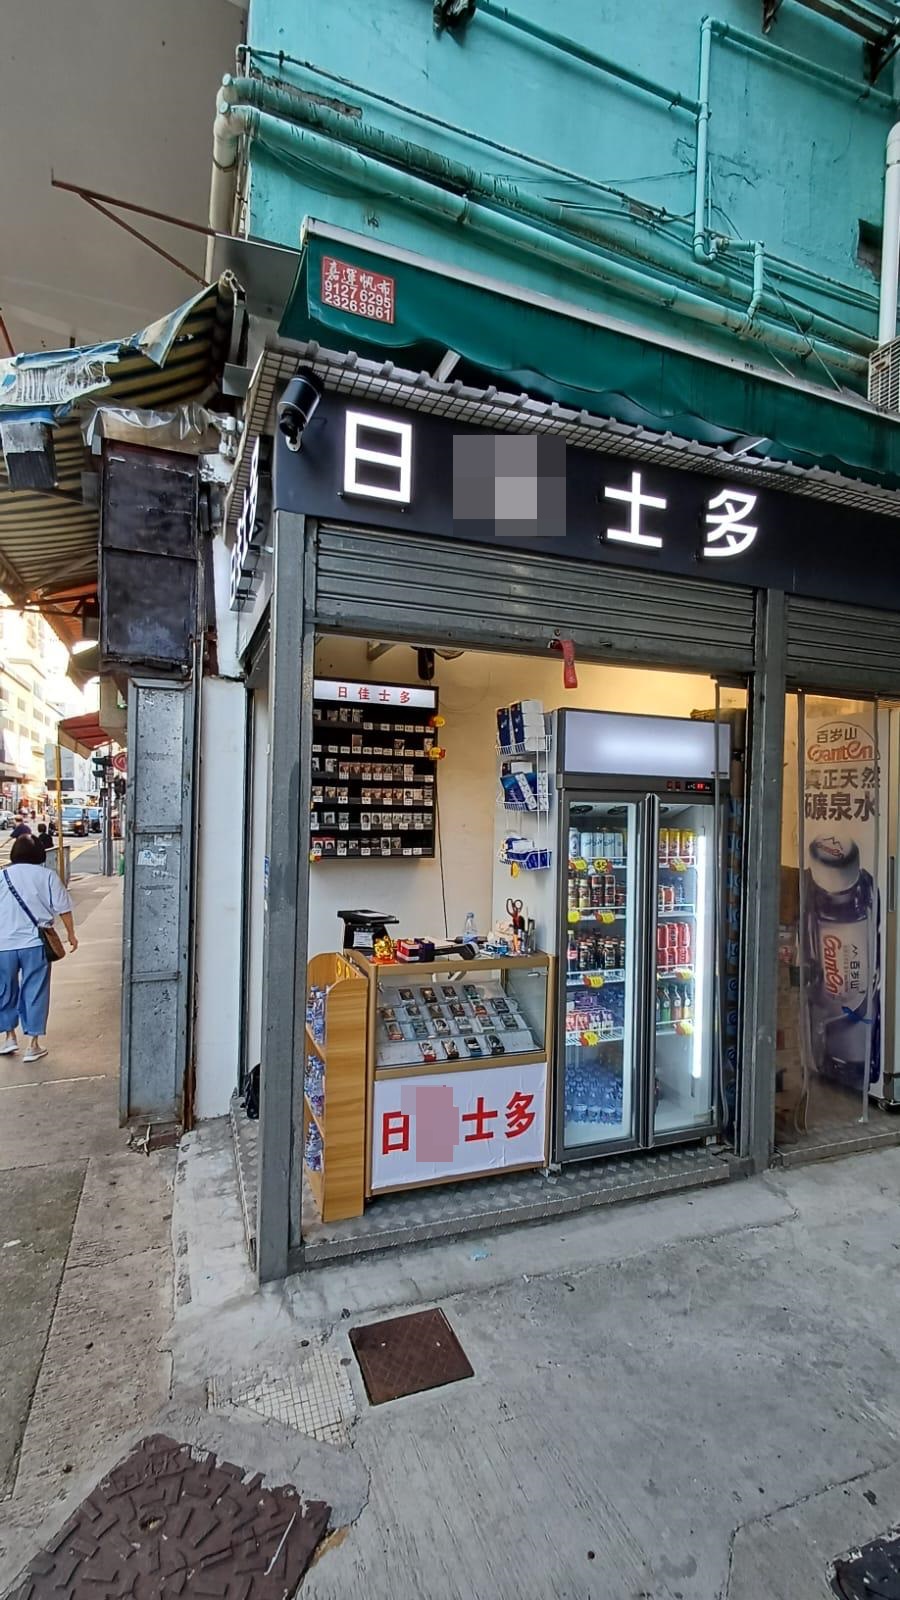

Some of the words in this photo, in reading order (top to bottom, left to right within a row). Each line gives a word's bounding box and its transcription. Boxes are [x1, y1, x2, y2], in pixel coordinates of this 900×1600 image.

[324, 280, 357, 300] 9127
[360, 290, 391, 308] 6295
[324, 292, 357, 312] 2326
[359, 302, 391, 320] 3961
[342, 409, 760, 558] 日士多
[338, 687, 411, 704] 日佳士多
[816, 727, 858, 744] 百岁山
[804, 766, 880, 789] 真正天然
[804, 791, 880, 822] 礦泉水
[381, 1090, 537, 1155] 日士多
